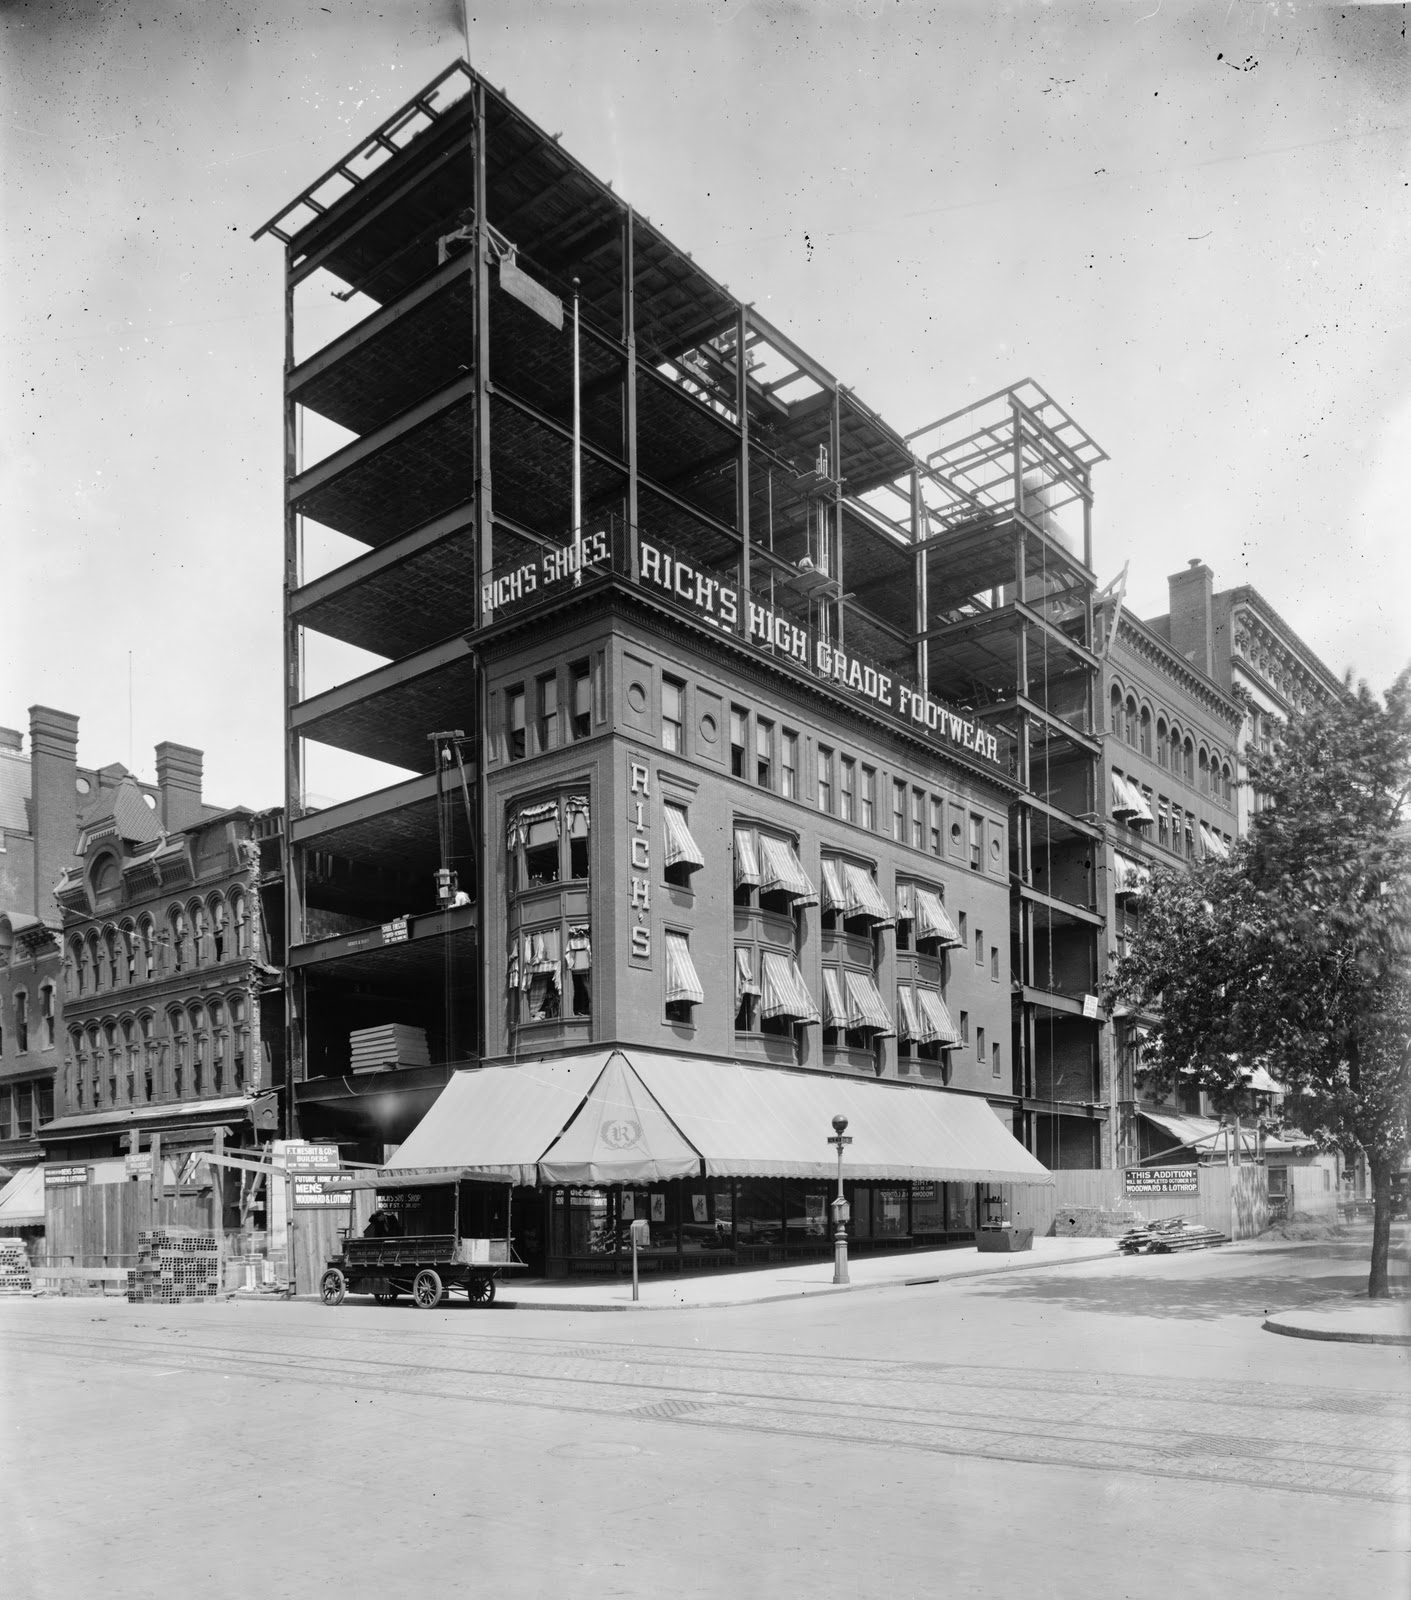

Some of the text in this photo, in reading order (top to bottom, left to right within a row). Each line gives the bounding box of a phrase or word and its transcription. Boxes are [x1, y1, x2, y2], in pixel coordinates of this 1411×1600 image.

[482, 531, 611, 613] RICH'S SHOES.
[641, 541, 1001, 764] RICH'S HIGH GRADE FOOTWEAR.
[631, 762, 651, 958] RICH'S
[296, 1183, 323, 1194] MEN'S
[1153, 1170, 1192, 1178] ADDITION
[295, 1195, 326, 1204] WOODWARD
[325, 1194, 331, 1204] &
